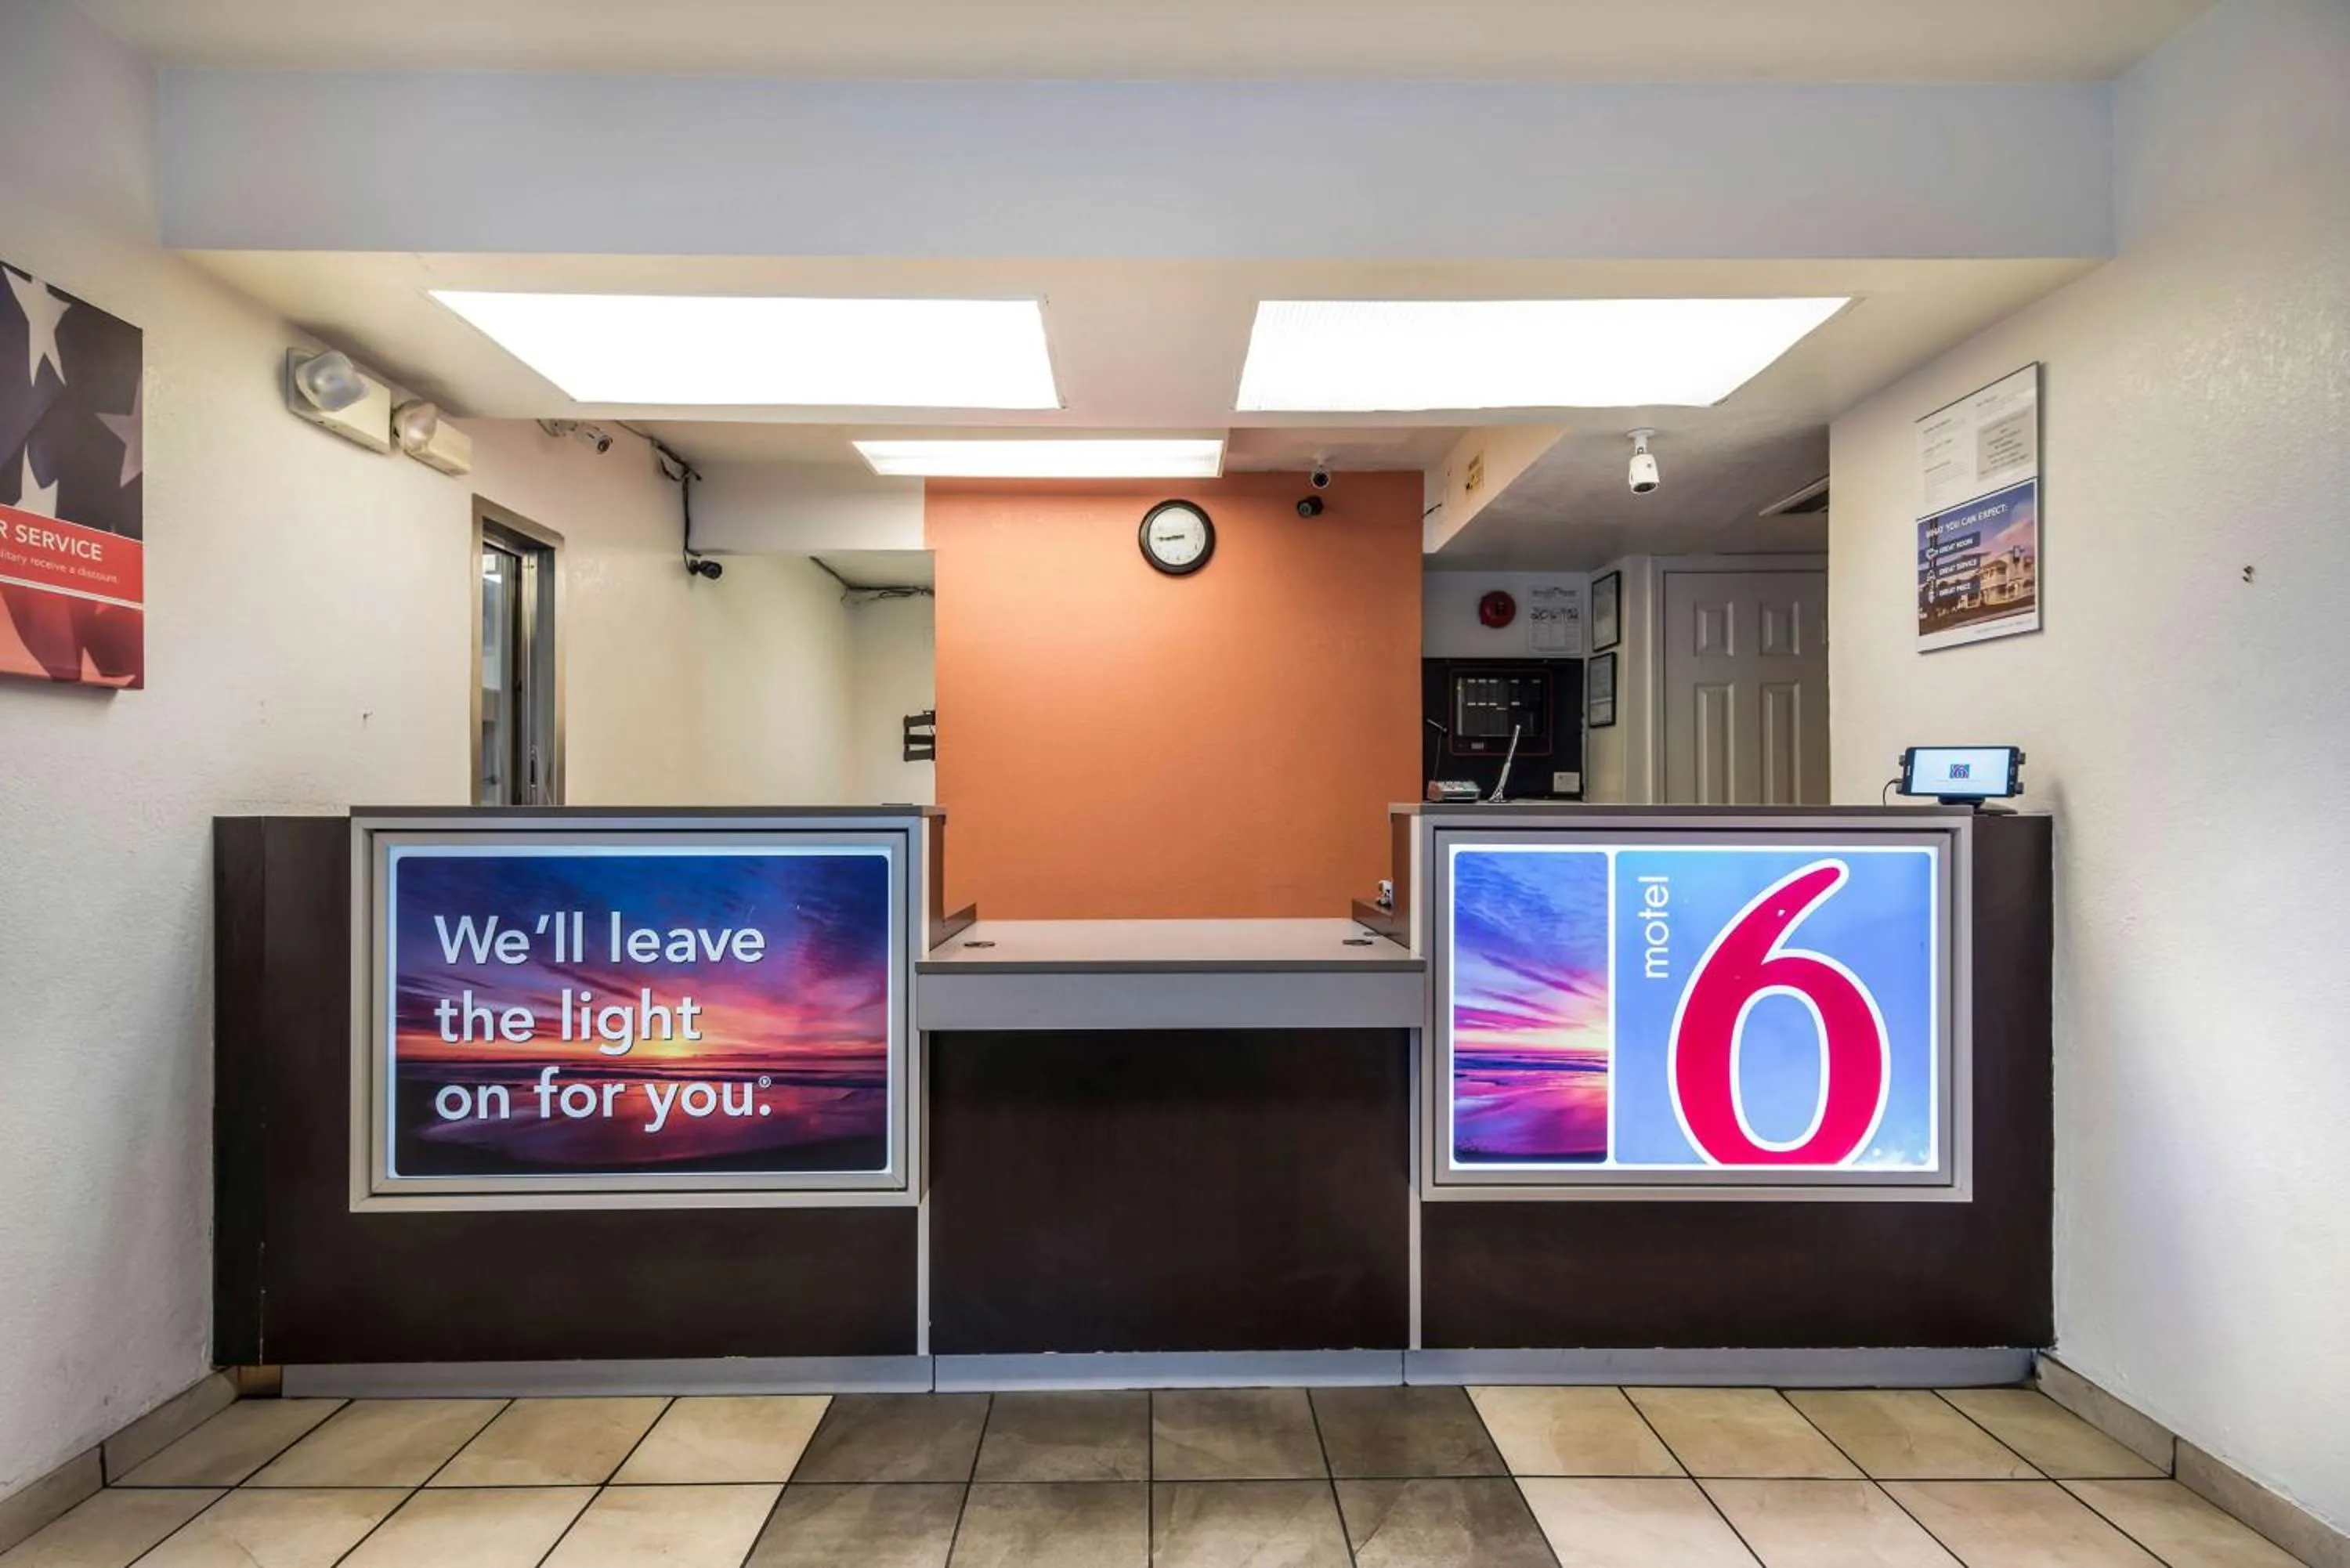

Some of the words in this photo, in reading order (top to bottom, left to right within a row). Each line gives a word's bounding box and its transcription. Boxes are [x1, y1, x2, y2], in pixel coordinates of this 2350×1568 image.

[15, 524, 103, 562] SERVICE
[1946, 522, 1960, 532] YOU
[1961, 515, 1976, 526] CAN
[30, 557, 67, 573] receive
[434, 911, 584, 965] We'll
[610, 911, 766, 963] leave
[434, 990, 536, 1042] the
[561, 988, 703, 1056] light
[1638, 876, 1668, 978] motel
[1667, 858, 1891, 1165] 6
[434, 1083, 511, 1120] on
[534, 1066, 627, 1120] for
